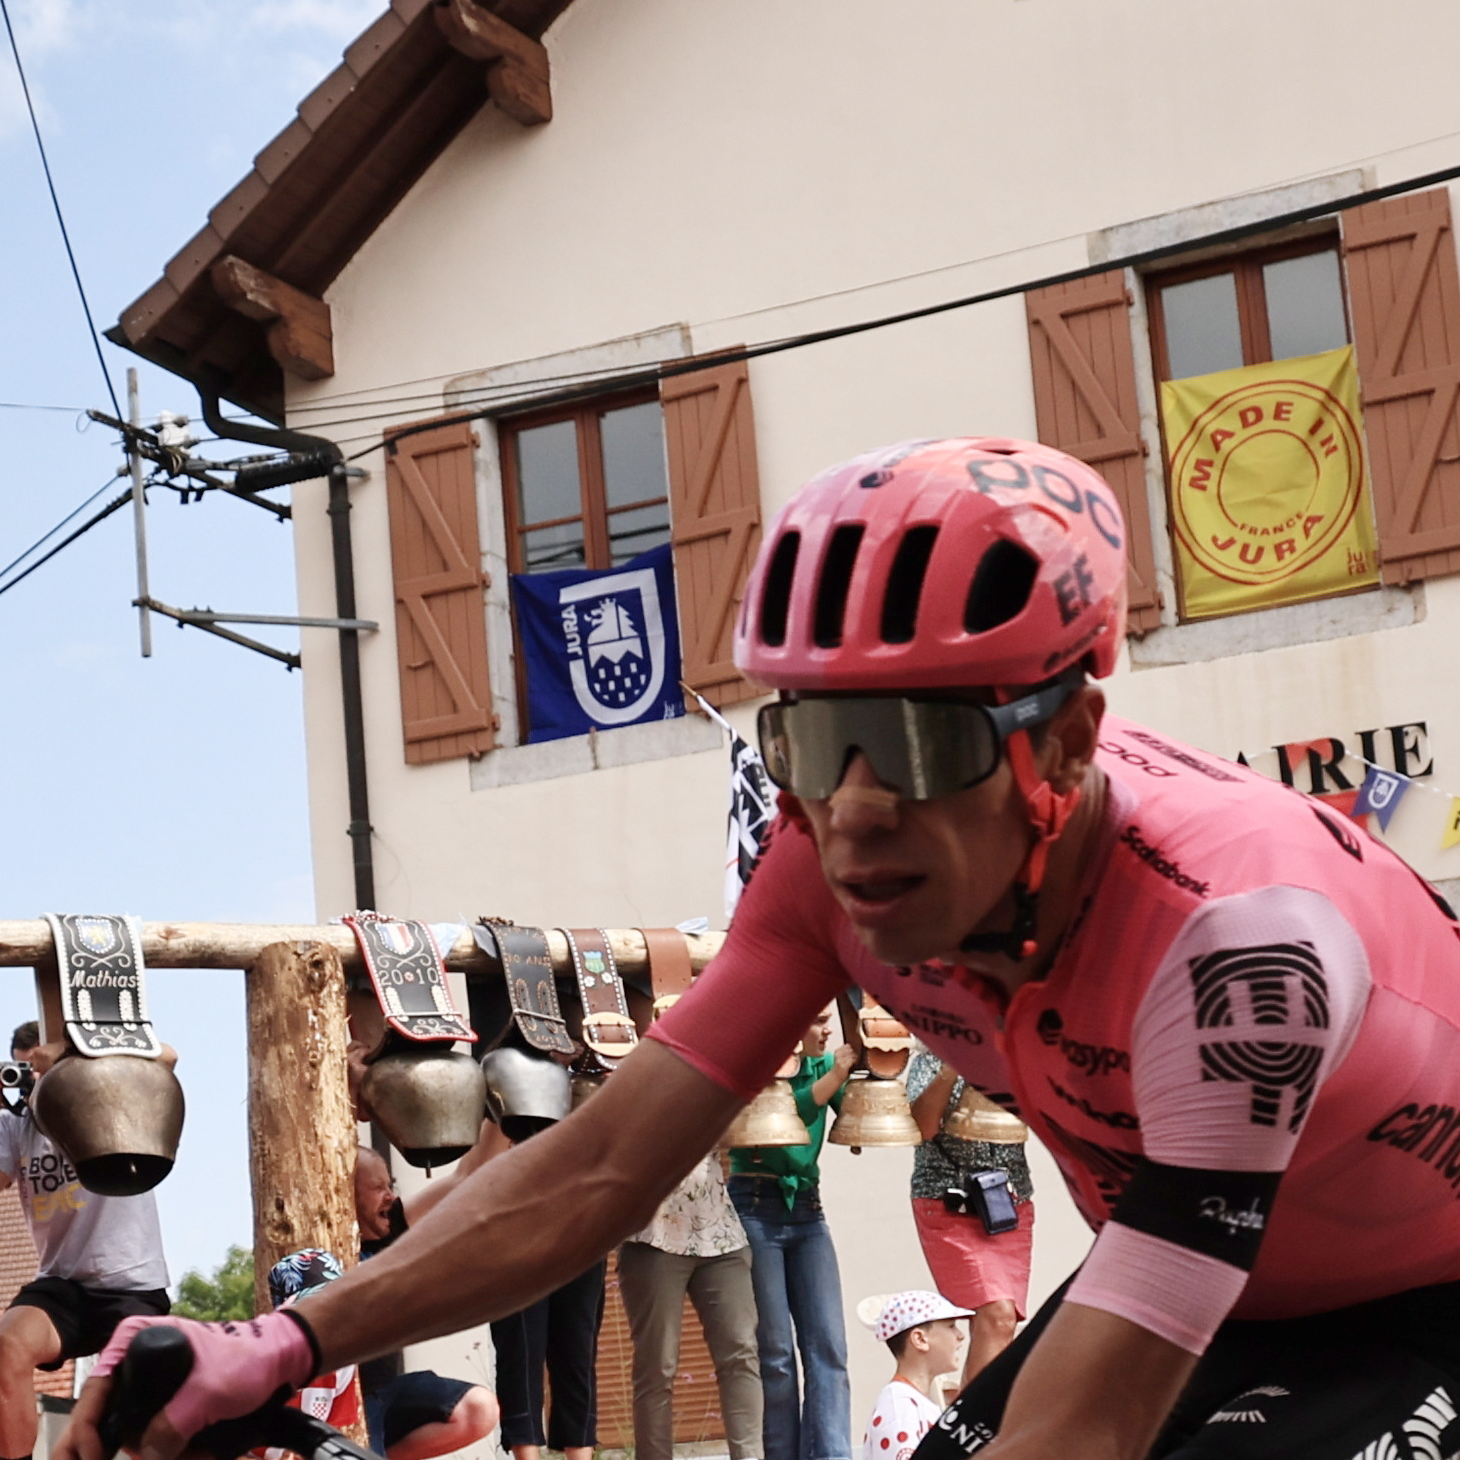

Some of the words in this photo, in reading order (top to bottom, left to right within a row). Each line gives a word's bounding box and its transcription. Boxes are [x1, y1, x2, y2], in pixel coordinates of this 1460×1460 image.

[1189, 401, 1294, 492] MADE
[1308, 417, 1338, 458] IN
[969, 458, 1122, 551] POC
[1211, 513, 1324, 565] JURA
[1239, 511, 1306, 537] FRANCE
[1054, 555, 1097, 630] EF
[559, 604, 582, 656] JURA
[1237, 721, 1434, 795] IRIE
[1121, 826, 1211, 899] Scotiabank
[70, 968, 138, 989] Mathias
